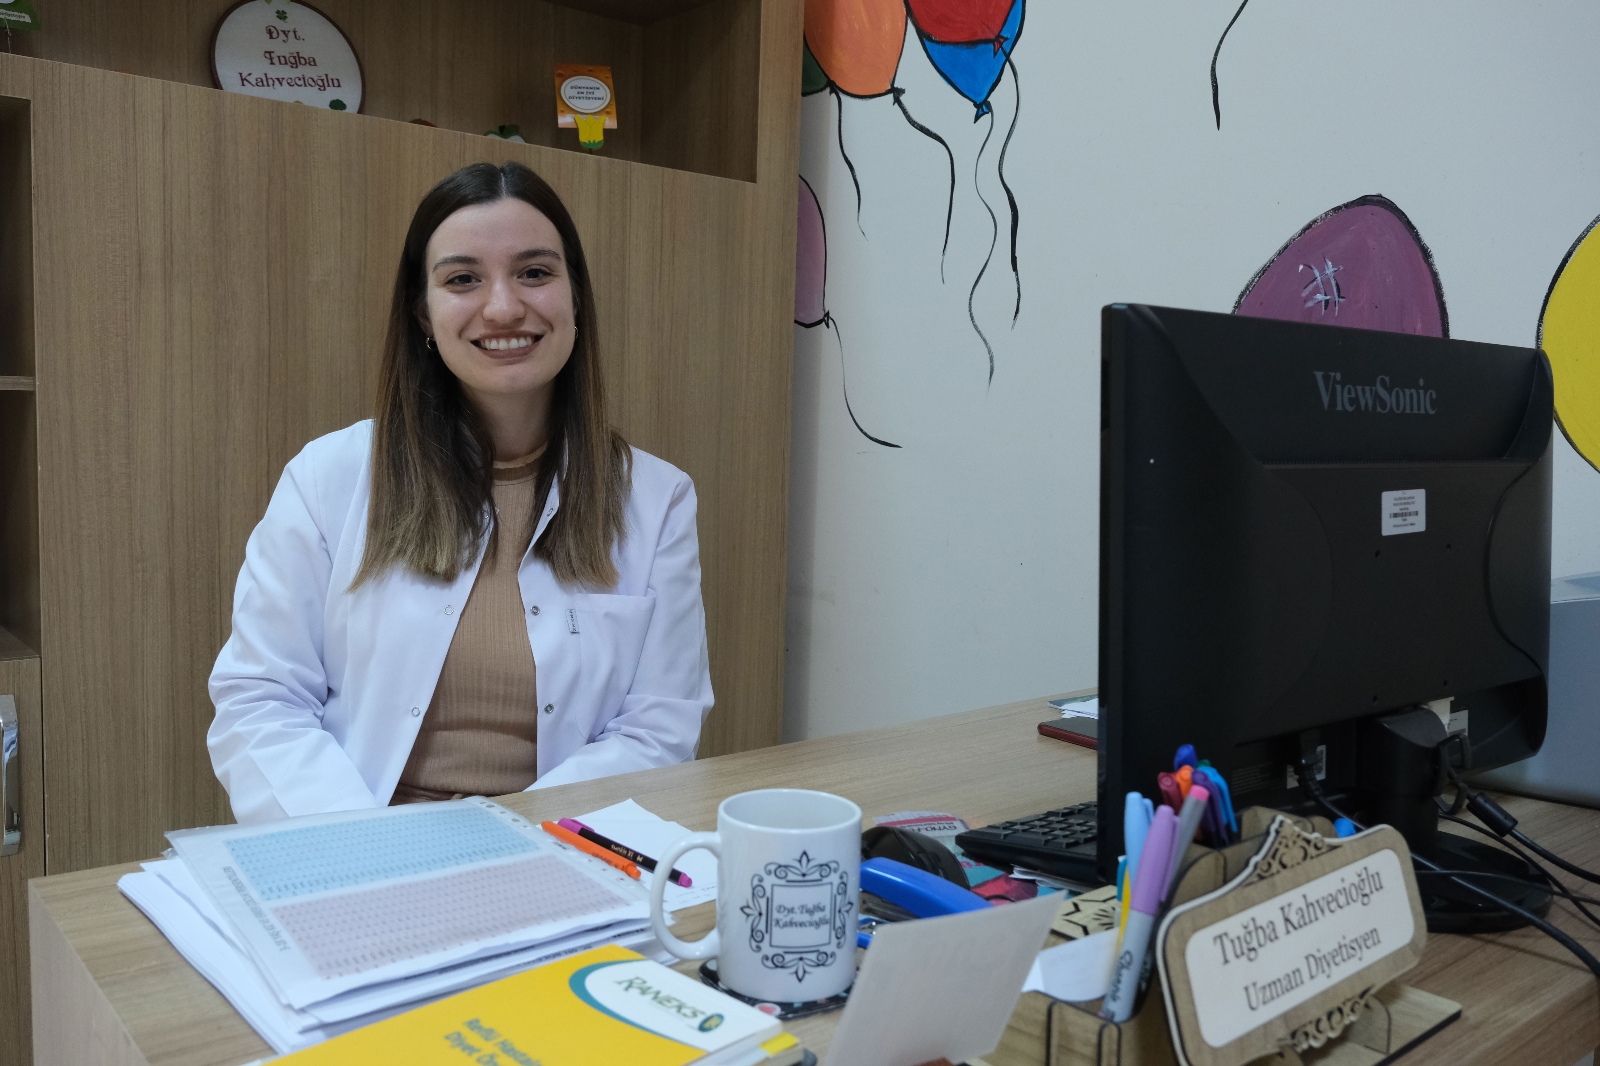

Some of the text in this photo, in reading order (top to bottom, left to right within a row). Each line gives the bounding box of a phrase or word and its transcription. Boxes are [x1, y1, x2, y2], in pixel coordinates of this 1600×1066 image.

[265, 25, 305, 43] Dyt.
[263, 51, 317, 69] Tuğba
[238, 72, 342, 92] Kahvecioğlu
[1313, 371, 1437, 415] ViewSonic
[1213, 866, 1384, 966] Tuğba Kahvecioğlu
[1243, 927, 1381, 1011] Uzman Diyetisyen
